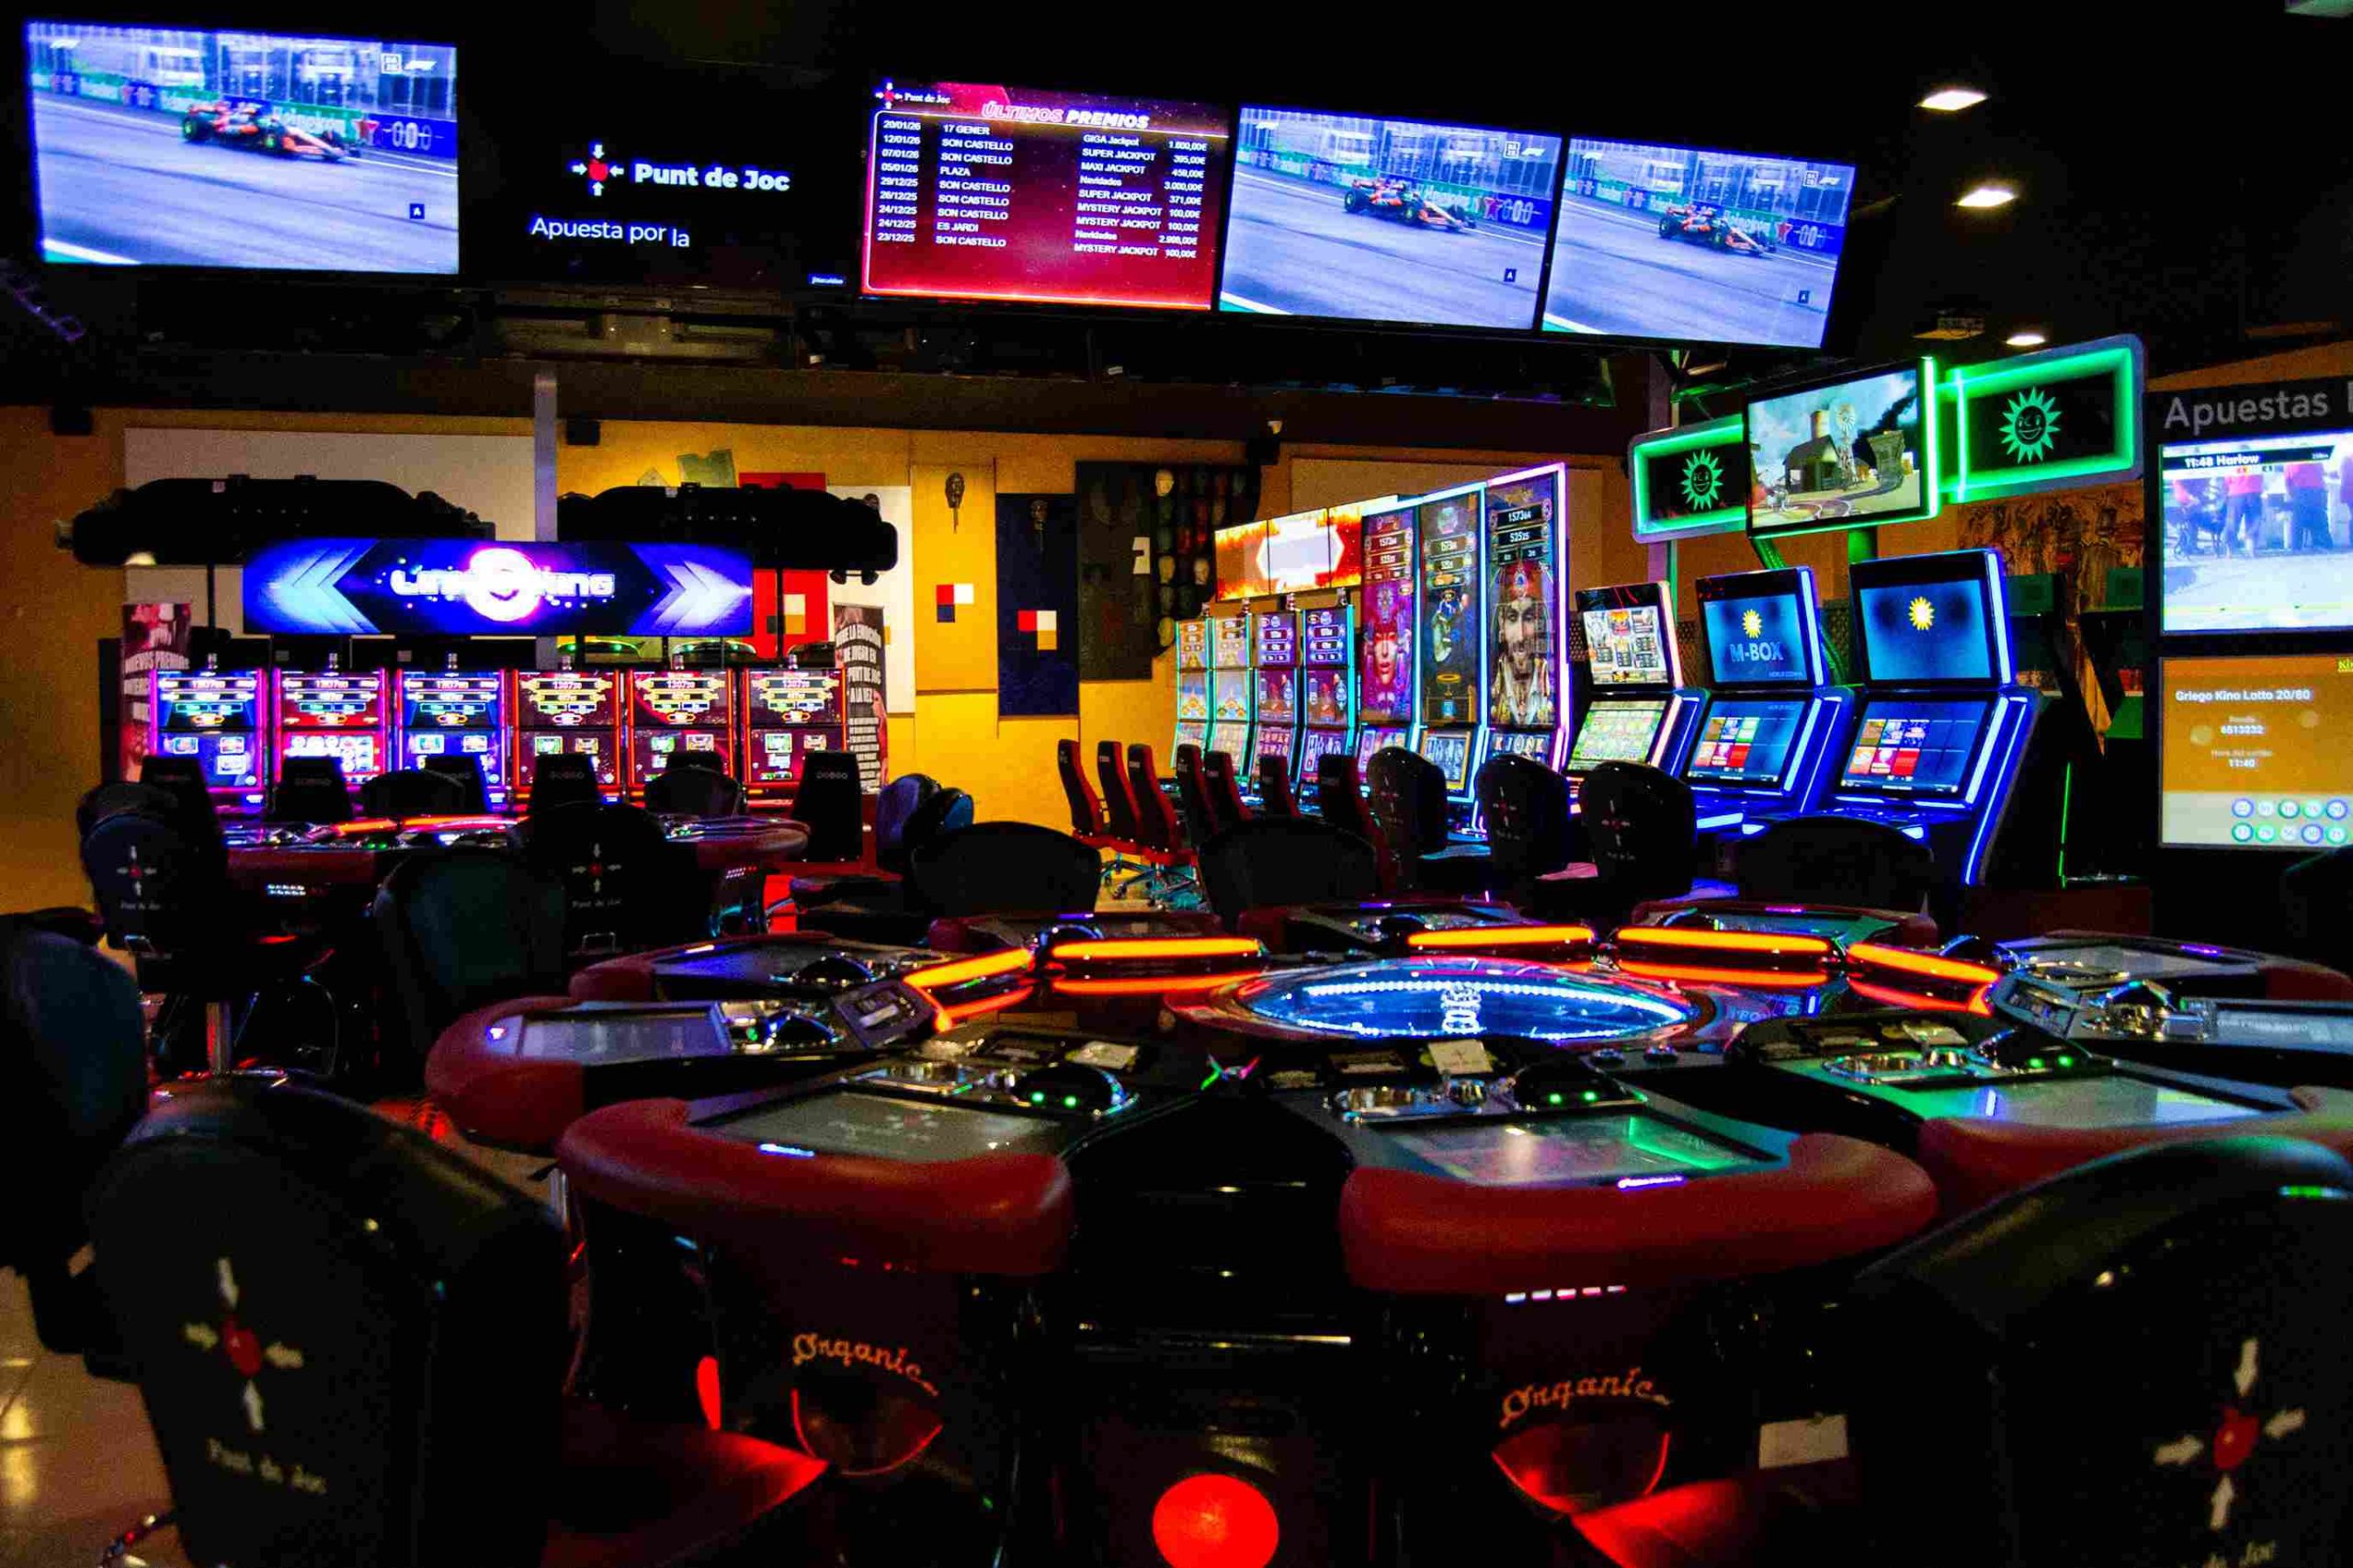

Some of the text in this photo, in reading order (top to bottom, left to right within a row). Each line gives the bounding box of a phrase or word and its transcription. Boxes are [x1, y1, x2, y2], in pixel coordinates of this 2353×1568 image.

[943, 124, 954, 133] 17
[955, 125, 990, 135] GENER
[1065, 109, 1150, 129] PREMIOS
[941, 139, 963, 148] SON
[964, 140, 1014, 151] CASTELLO
[1082, 148, 1114, 158] SUPER
[1115, 151, 1156, 161] JACKPOT
[939, 166, 972, 176] PLAZA
[940, 153, 961, 162] SON
[963, 153, 1012, 165] CASTELLO
[1104, 164, 1146, 174] JACKPOT
[634, 163, 790, 191] Punt de Joc
[938, 180, 961, 190] SON
[961, 182, 1011, 192] CASTELLO
[1078, 189, 1110, 199] SUPER
[1111, 191, 1153, 202] JACKPOT
[938, 194, 960, 204] SON
[961, 196, 1009, 206] CASTELLO
[1077, 203, 1121, 213] MYSTERY
[1121, 206, 1163, 216] JACKPOT
[938, 208, 959, 218] SON
[960, 210, 1008, 220] CASTELLO
[1076, 216, 1120, 226] MYSTERY
[1120, 219, 1162, 229] JACKPOT
[530, 217, 690, 248] Apuesta por la
[936, 235, 957, 245] SON
[958, 236, 1006, 247] CASTELLO
[1074, 244, 1117, 254] MYSTERY
[1118, 245, 1159, 256] JACKPOT
[2164, 390, 2329, 437] Apuestas
[2215, 453, 2260, 466] Harlow
[1730, 642, 1784, 662] M-BOX
[2175, 688, 2311, 702] Griego Kino Lotto 20/80
[792, 1331, 940, 1397] Organic
[1499, 1366, 1672, 1430] Organic
